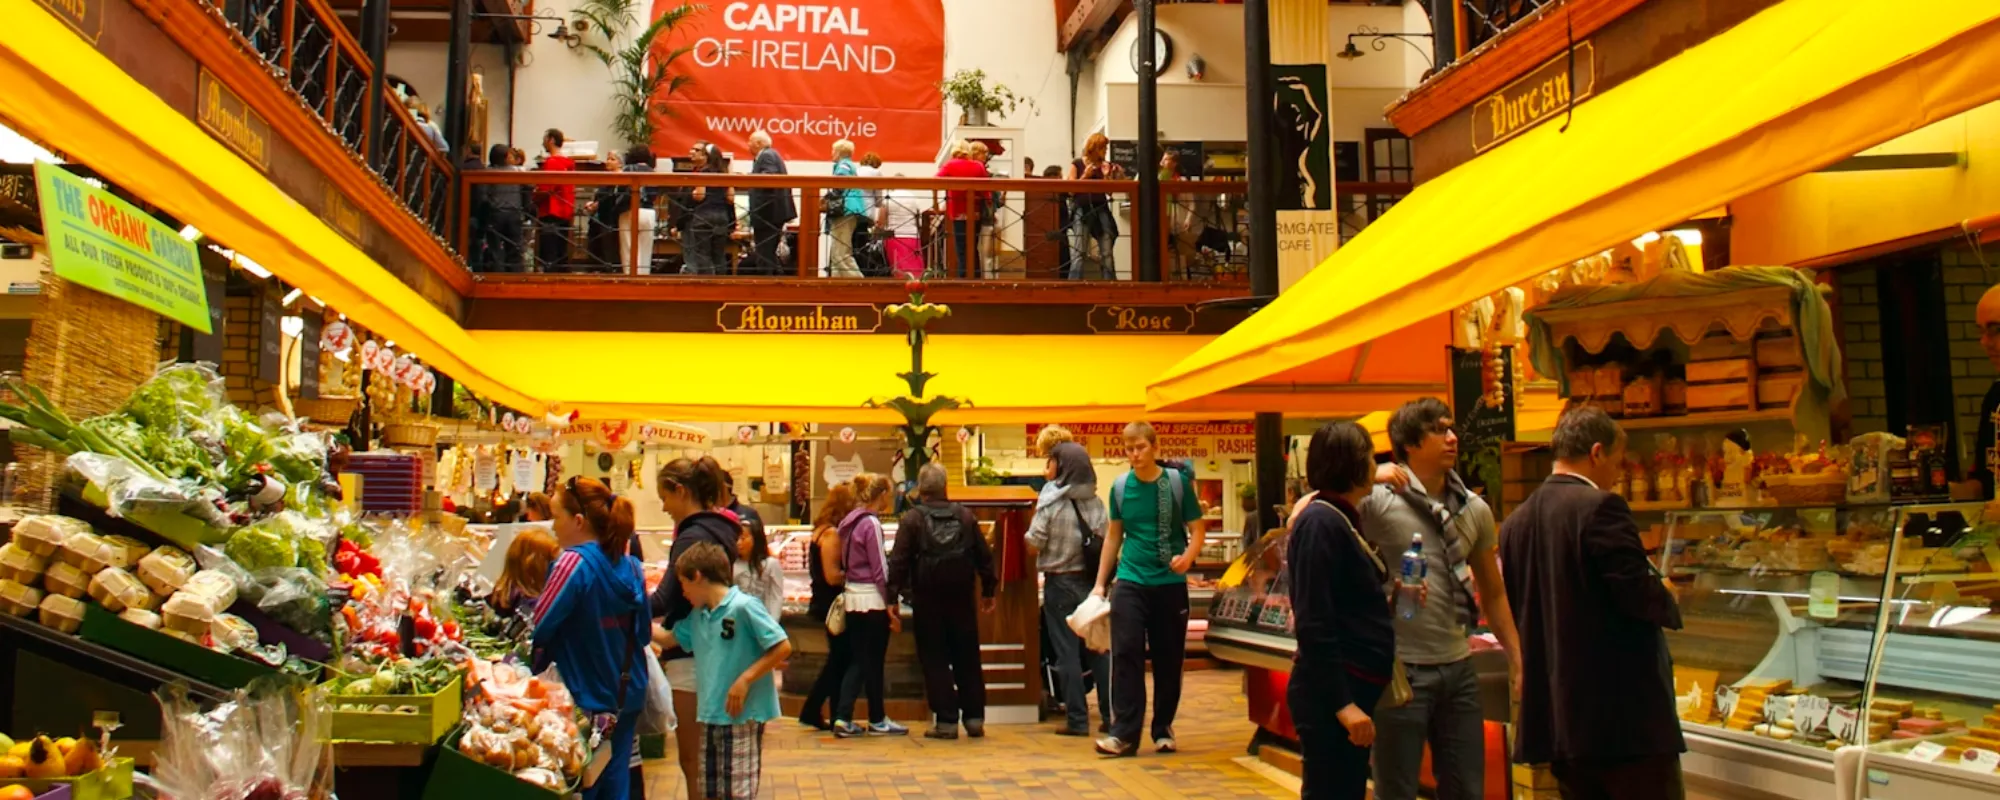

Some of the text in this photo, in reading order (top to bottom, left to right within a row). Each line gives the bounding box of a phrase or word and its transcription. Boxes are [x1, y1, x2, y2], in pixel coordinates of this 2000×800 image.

[723, 2, 869, 36] CAPITAL
[693, 37, 896, 74] OF IRELAND
[1490, 71, 1571, 139] Durcan
[706, 112, 877, 139] www.corkcity.ie
[52, 175, 85, 222] THE
[87, 194, 151, 253] ORGANIC
[64, 233, 80, 255] ALL
[737, 304, 858, 331] Moynihan
[1107, 305, 1172, 329] Rose
[1087, 424, 1114, 434] HAM
[1173, 424, 1247, 434] SPECIALISTS
[1160, 448, 1208, 458] PORK RIB
[720, 617, 736, 641] 5
